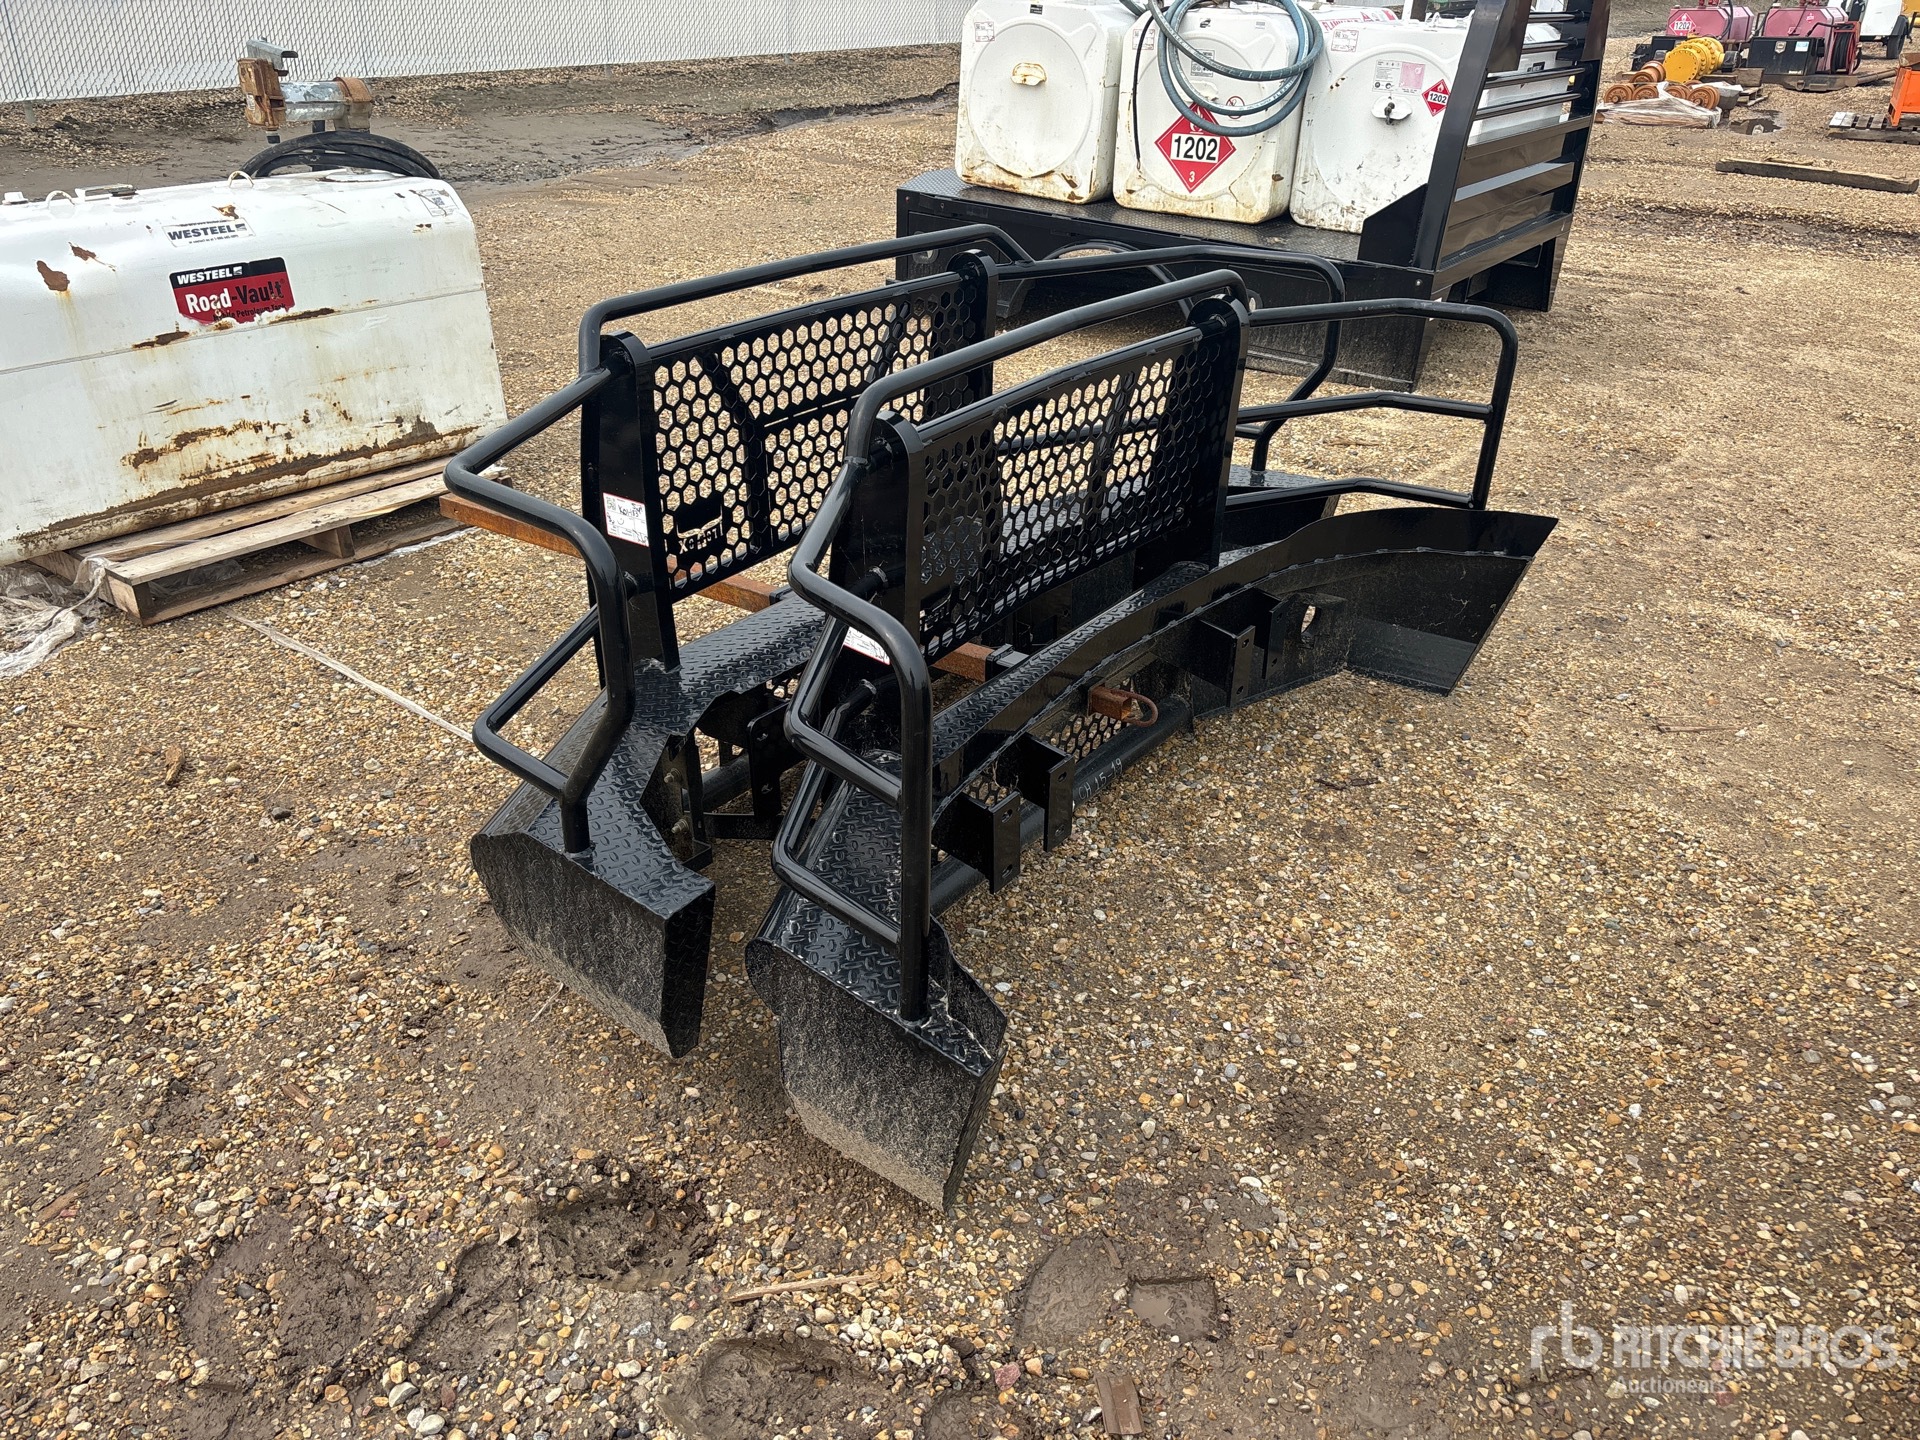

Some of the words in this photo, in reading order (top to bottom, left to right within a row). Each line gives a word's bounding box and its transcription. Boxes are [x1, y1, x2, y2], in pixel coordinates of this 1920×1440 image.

[1429, 92, 1447, 104] 1202
[1173, 135, 1218, 161] 1202
[1188, 170, 1196, 183] 3
[167, 225, 236, 241] WESTEEL
[176, 267, 233, 285] WESTEEL
[185, 280, 284, 314] Road-Vault
[213, 311, 236, 321] Mbile
